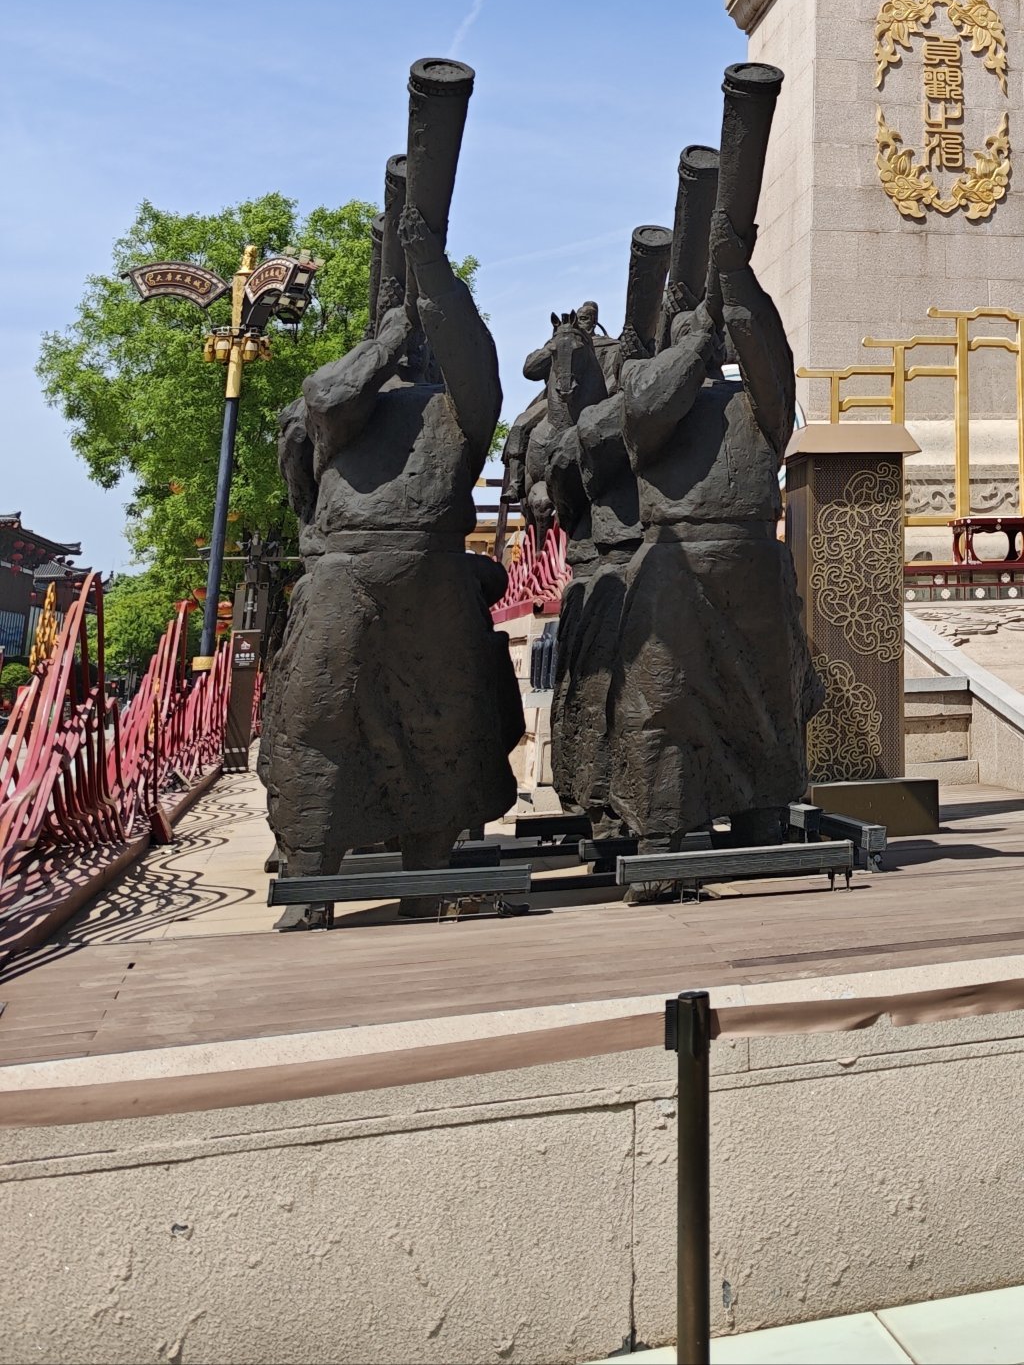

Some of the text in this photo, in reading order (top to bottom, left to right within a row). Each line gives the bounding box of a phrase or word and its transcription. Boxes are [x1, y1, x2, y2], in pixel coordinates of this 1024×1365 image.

[155, 272, 202, 289] 大唐不夜城
